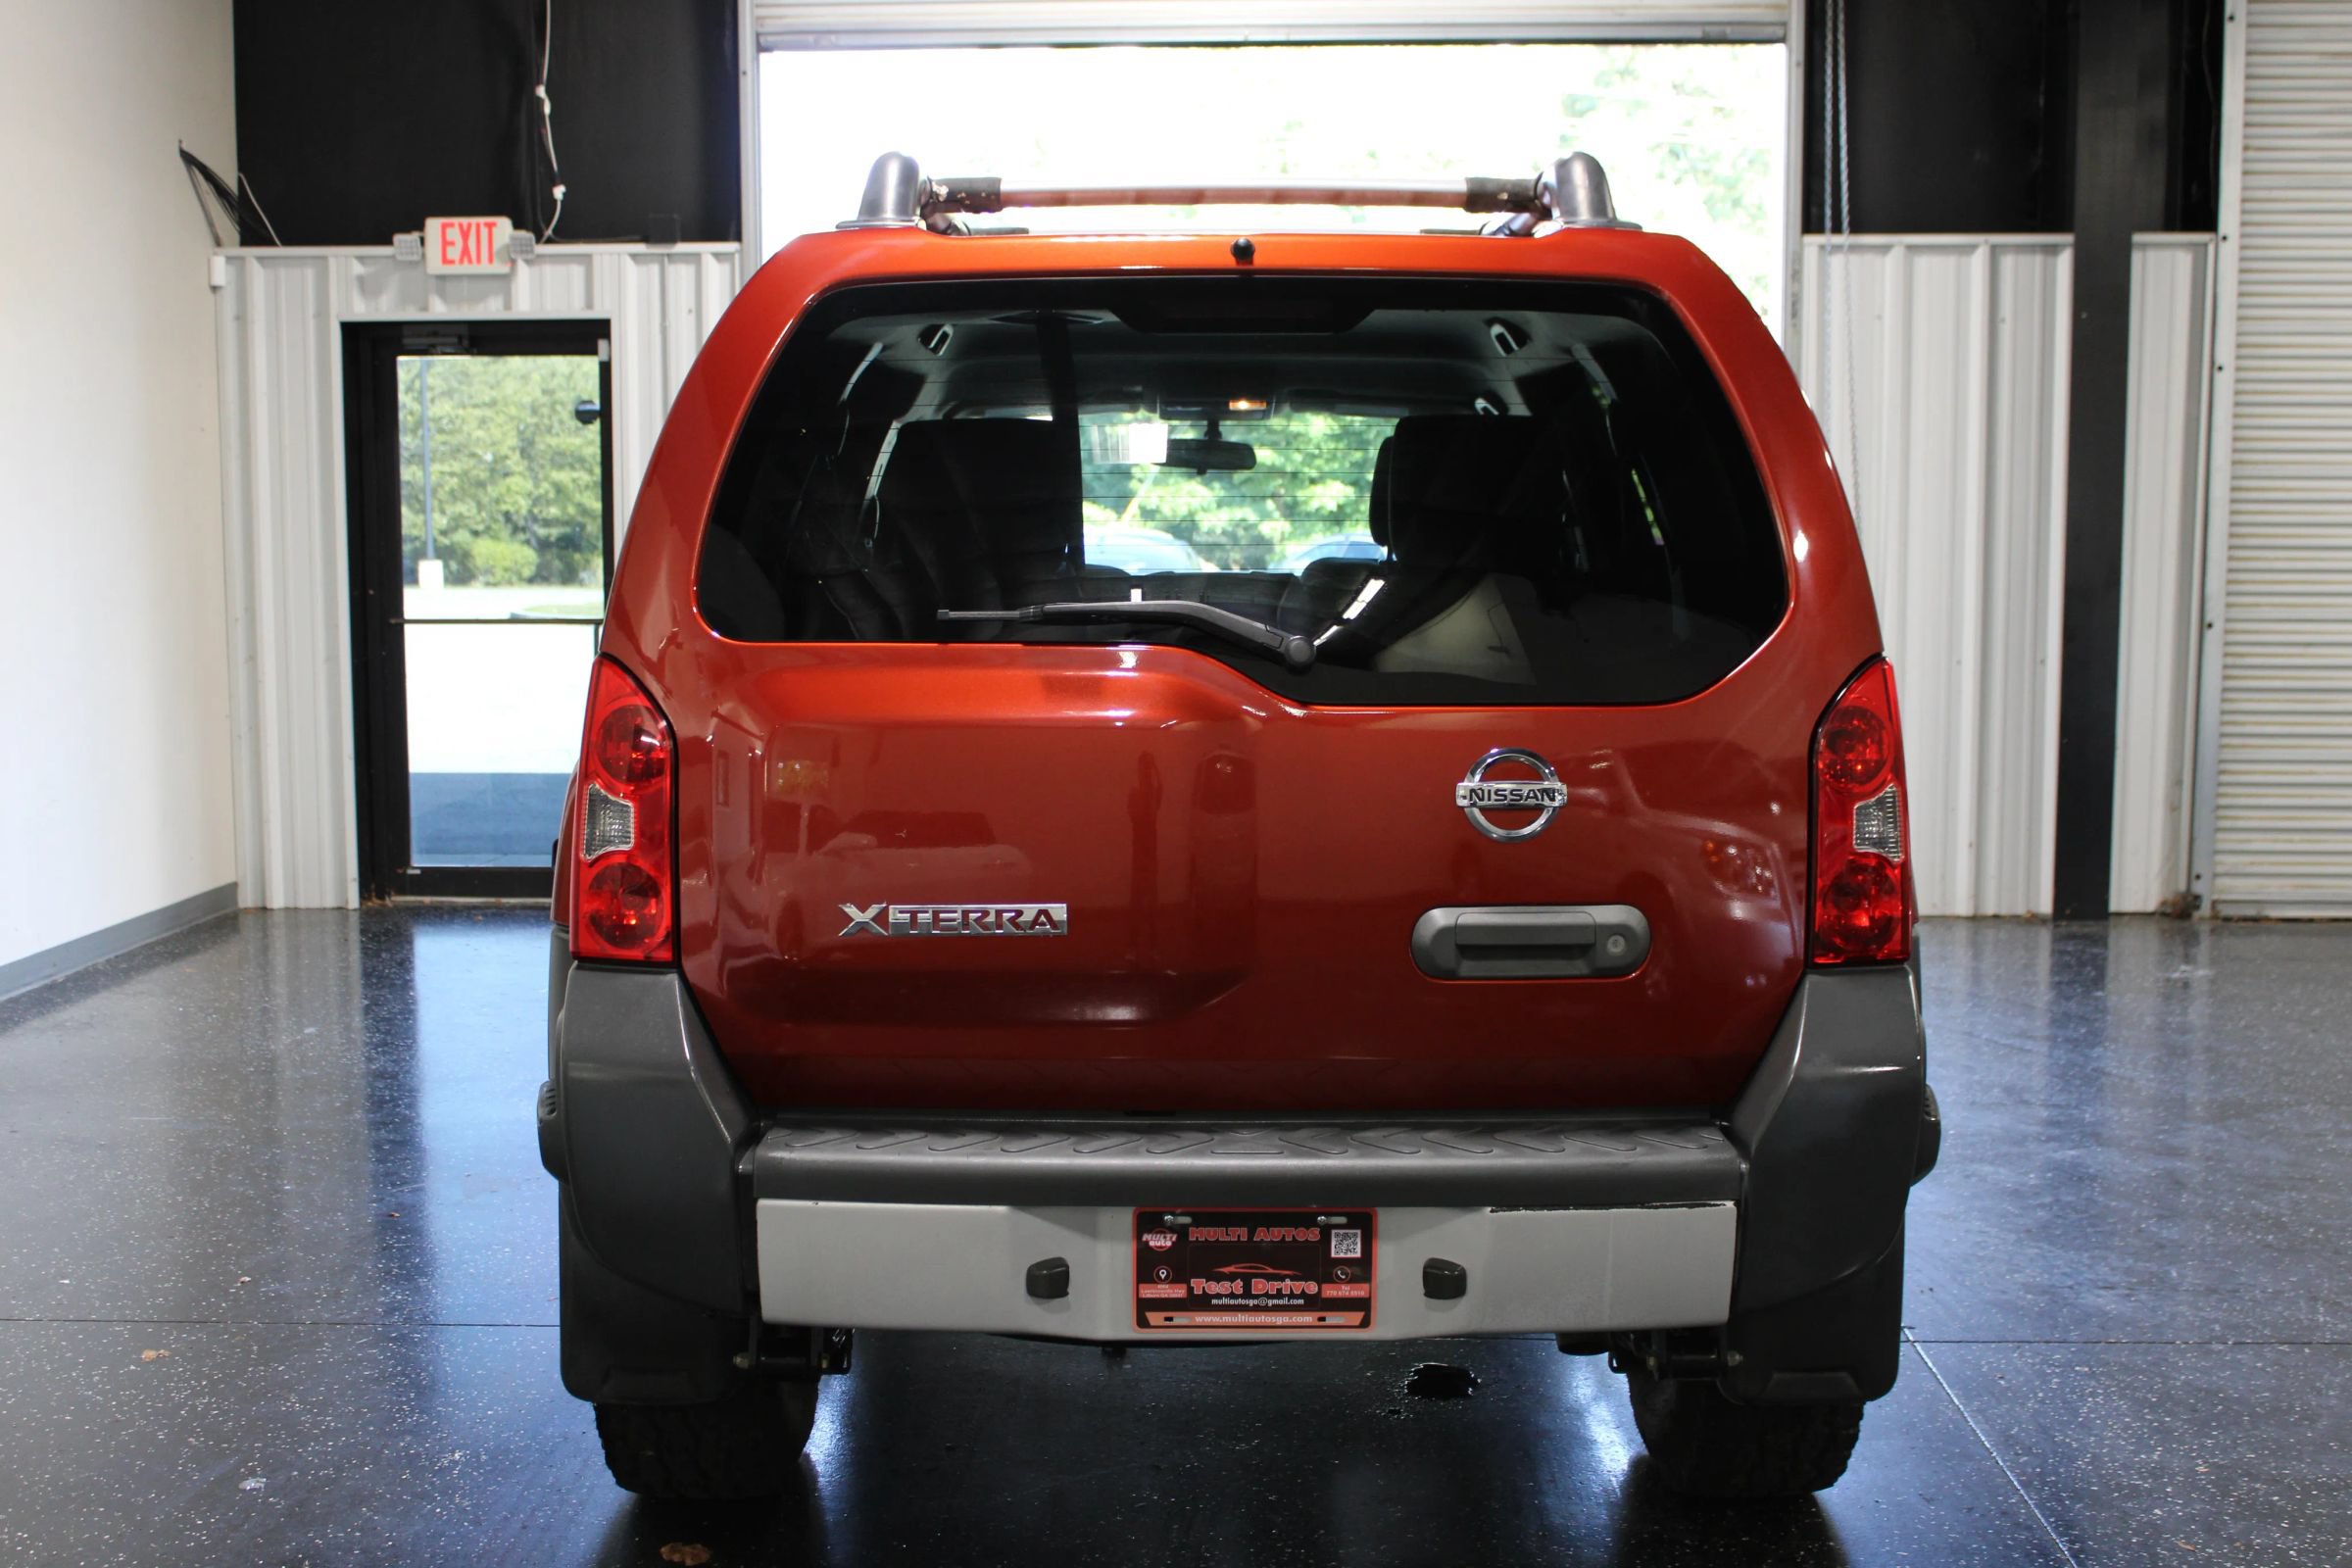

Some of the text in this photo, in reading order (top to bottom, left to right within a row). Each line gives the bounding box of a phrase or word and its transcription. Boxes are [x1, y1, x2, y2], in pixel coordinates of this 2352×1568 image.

[440, 220, 498, 266] EXIT
[1469, 787, 1556, 803] NISSAN
[839, 902, 1067, 937] XTERRA
[1142, 1233, 1178, 1242] MULTI
[1189, 1227, 1320, 1241] MULTI AUTOS
[1191, 1278, 1318, 1295] Test Drive
[1211, 1297, 1304, 1307] multiautosga@gmail.com
[1195, 1313, 1313, 1325] www.multiautosga.com
